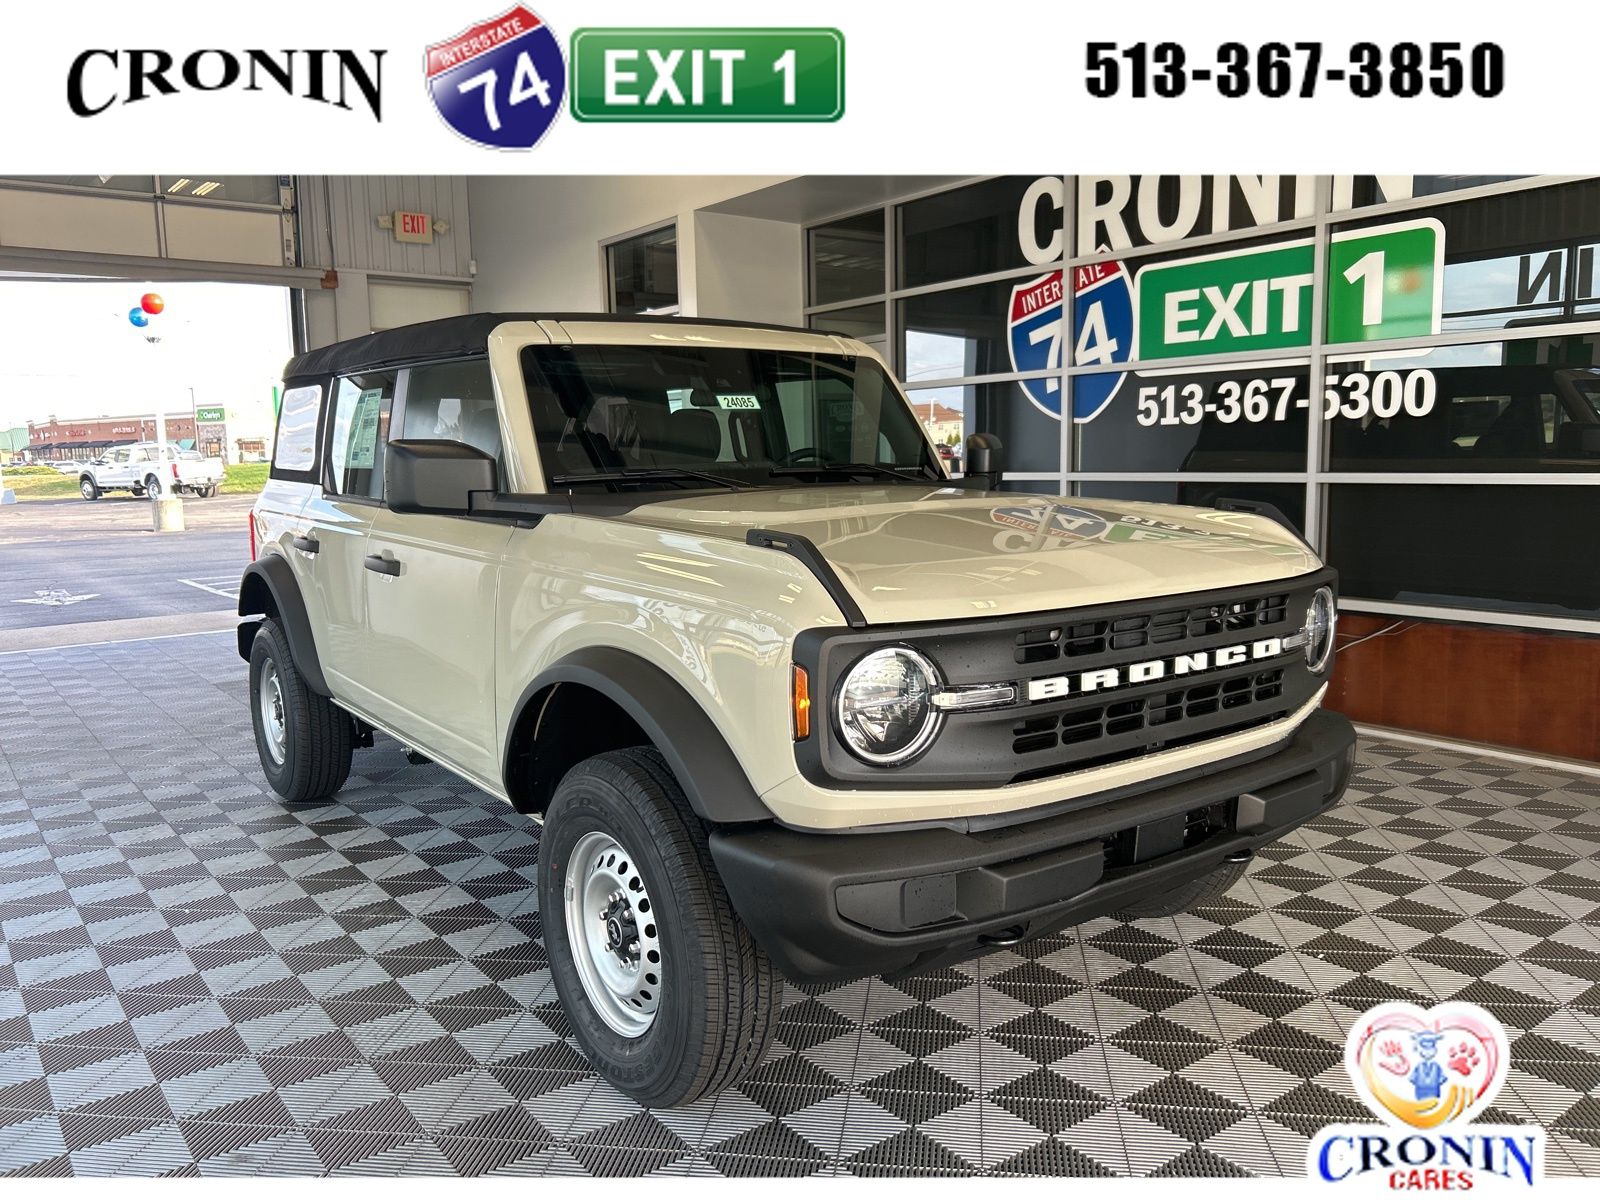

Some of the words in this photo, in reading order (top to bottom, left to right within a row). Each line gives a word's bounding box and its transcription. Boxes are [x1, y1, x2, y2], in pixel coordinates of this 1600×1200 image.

[402, 214, 426, 234] EXIT
[1018, 174, 1414, 265] CRON
[1021, 263, 1106, 314] INTERATE
[1164, 273, 1314, 345] EXIT
[1343, 250, 1385, 326] 1
[1028, 300, 1118, 394] 74
[723, 397, 755, 408] 24085
[1136, 369, 1436, 427] 513-367-5300
[1028, 637, 1283, 702] BRONCO
